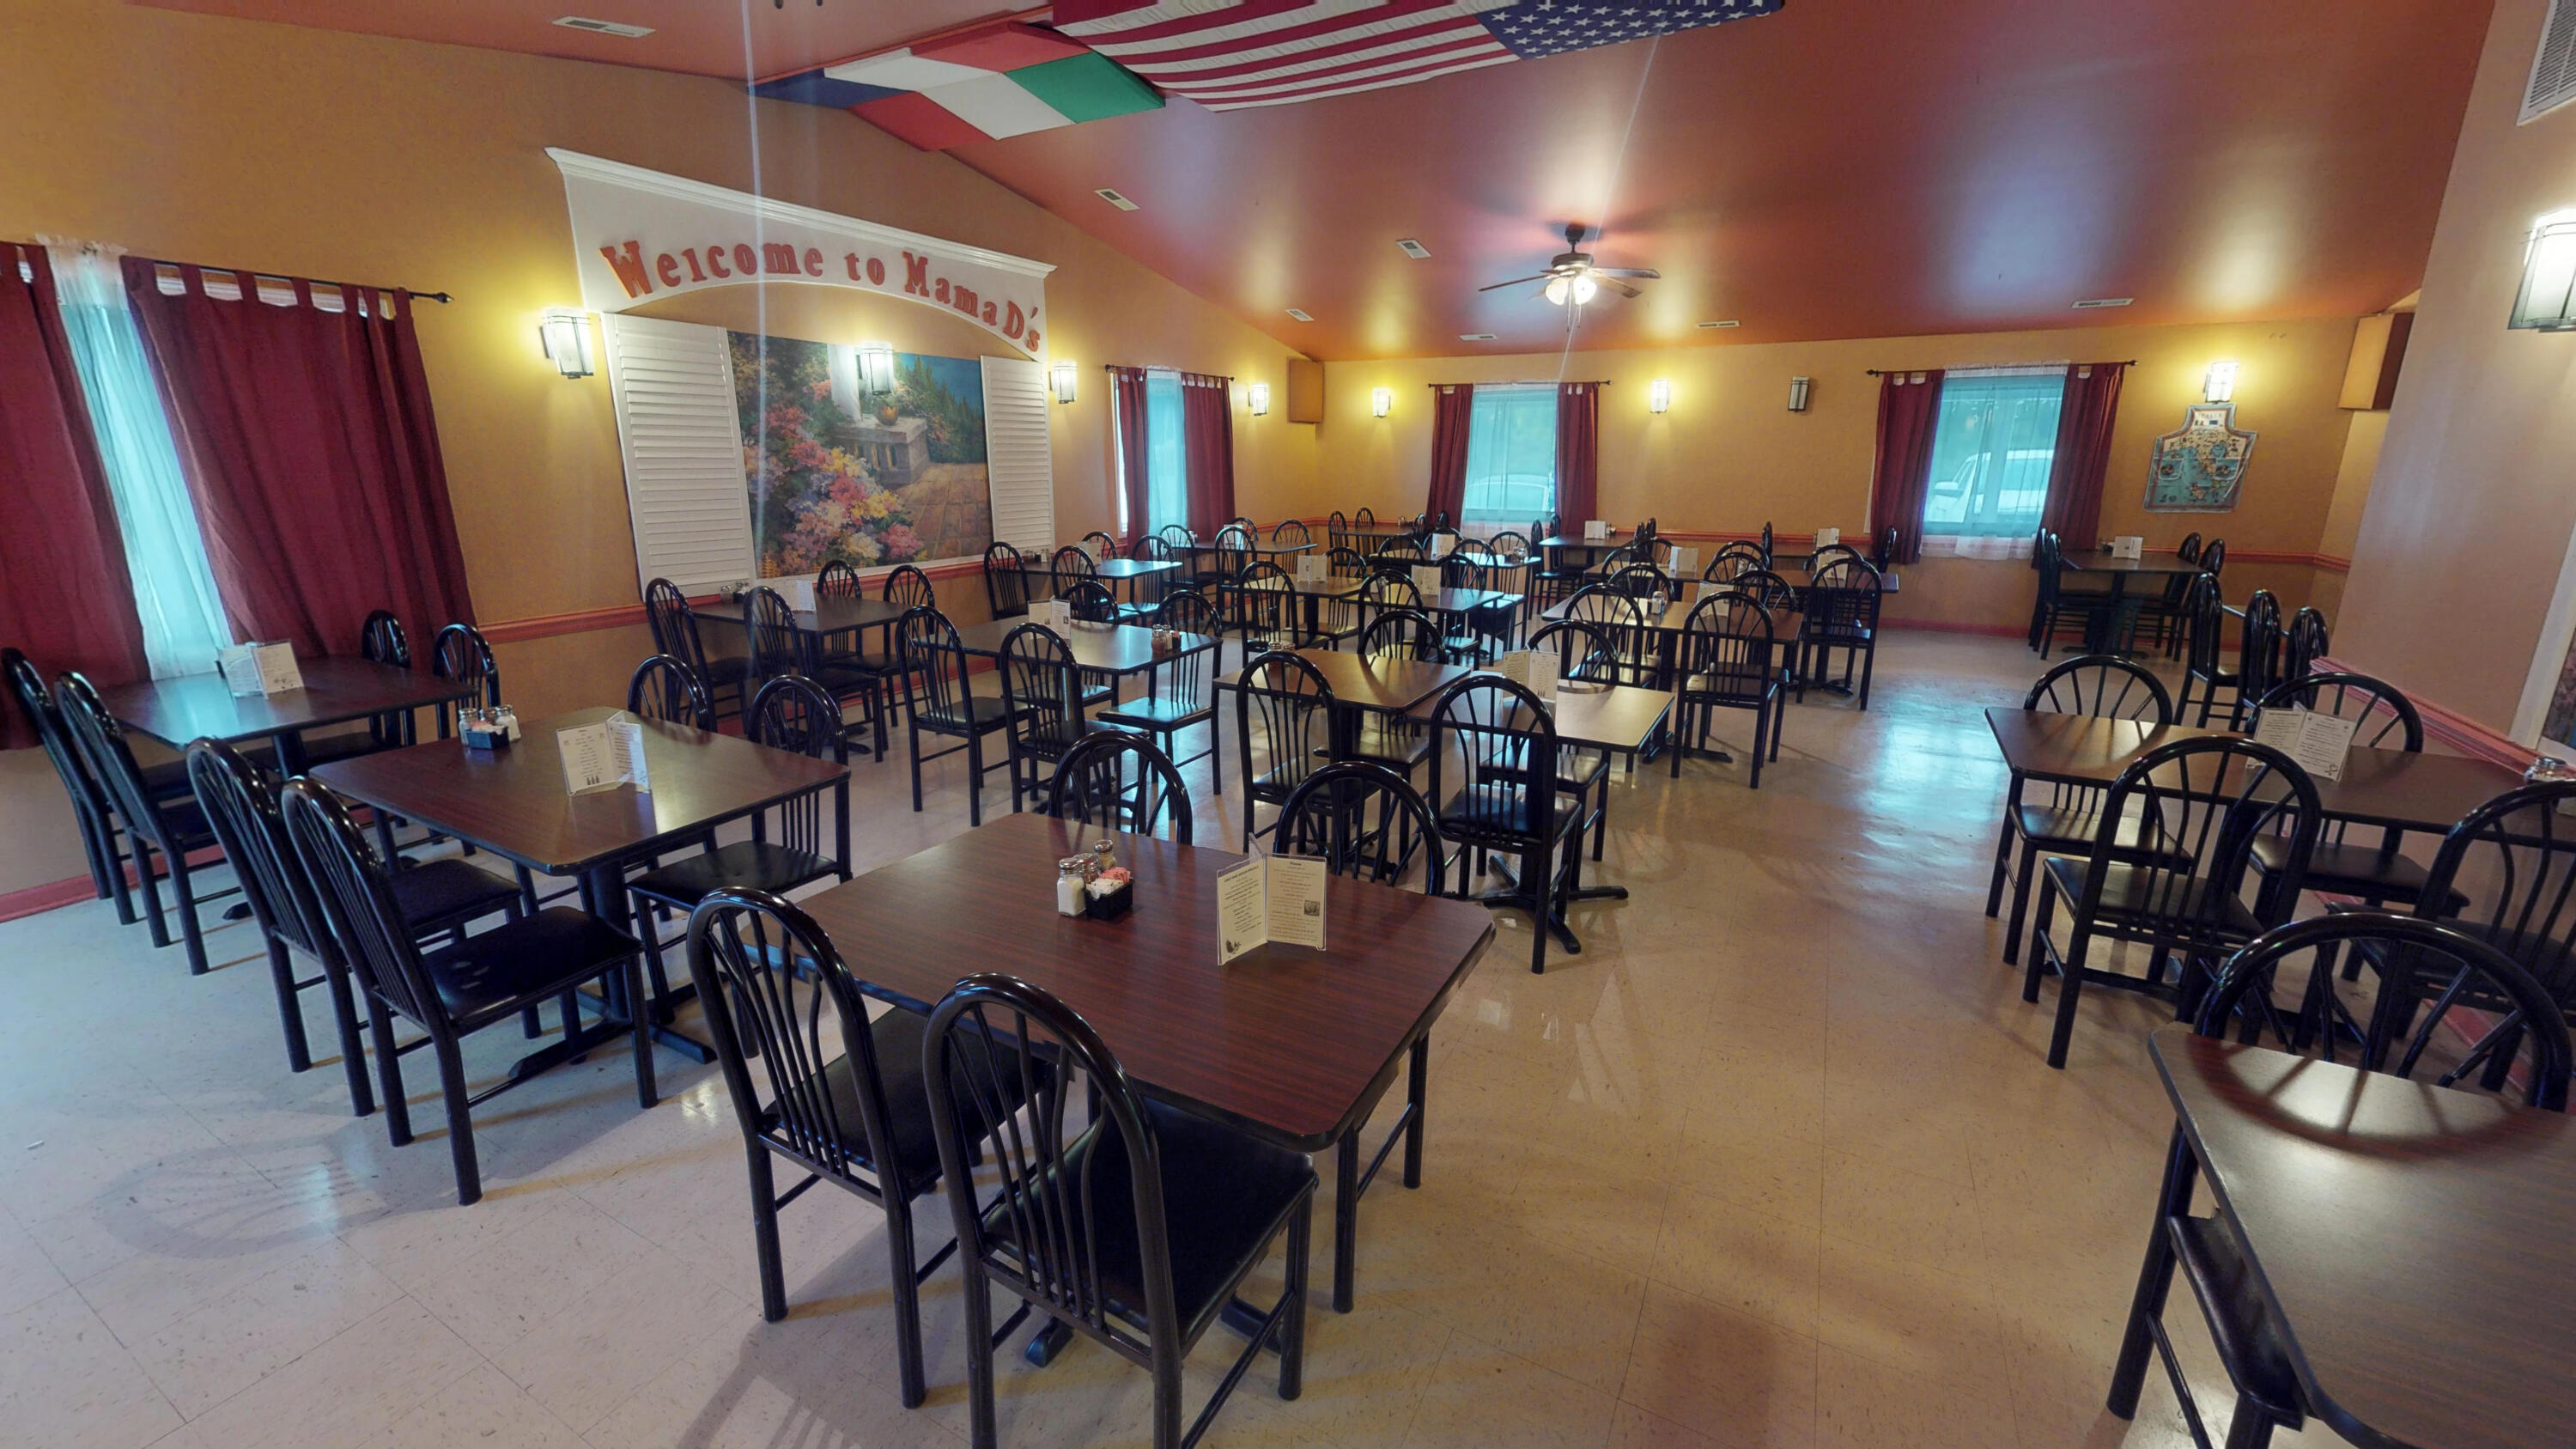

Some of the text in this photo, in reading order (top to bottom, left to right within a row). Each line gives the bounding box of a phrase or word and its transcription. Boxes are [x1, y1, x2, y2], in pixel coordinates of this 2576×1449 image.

[599, 240, 1041, 352] Welcome to MamaD's
